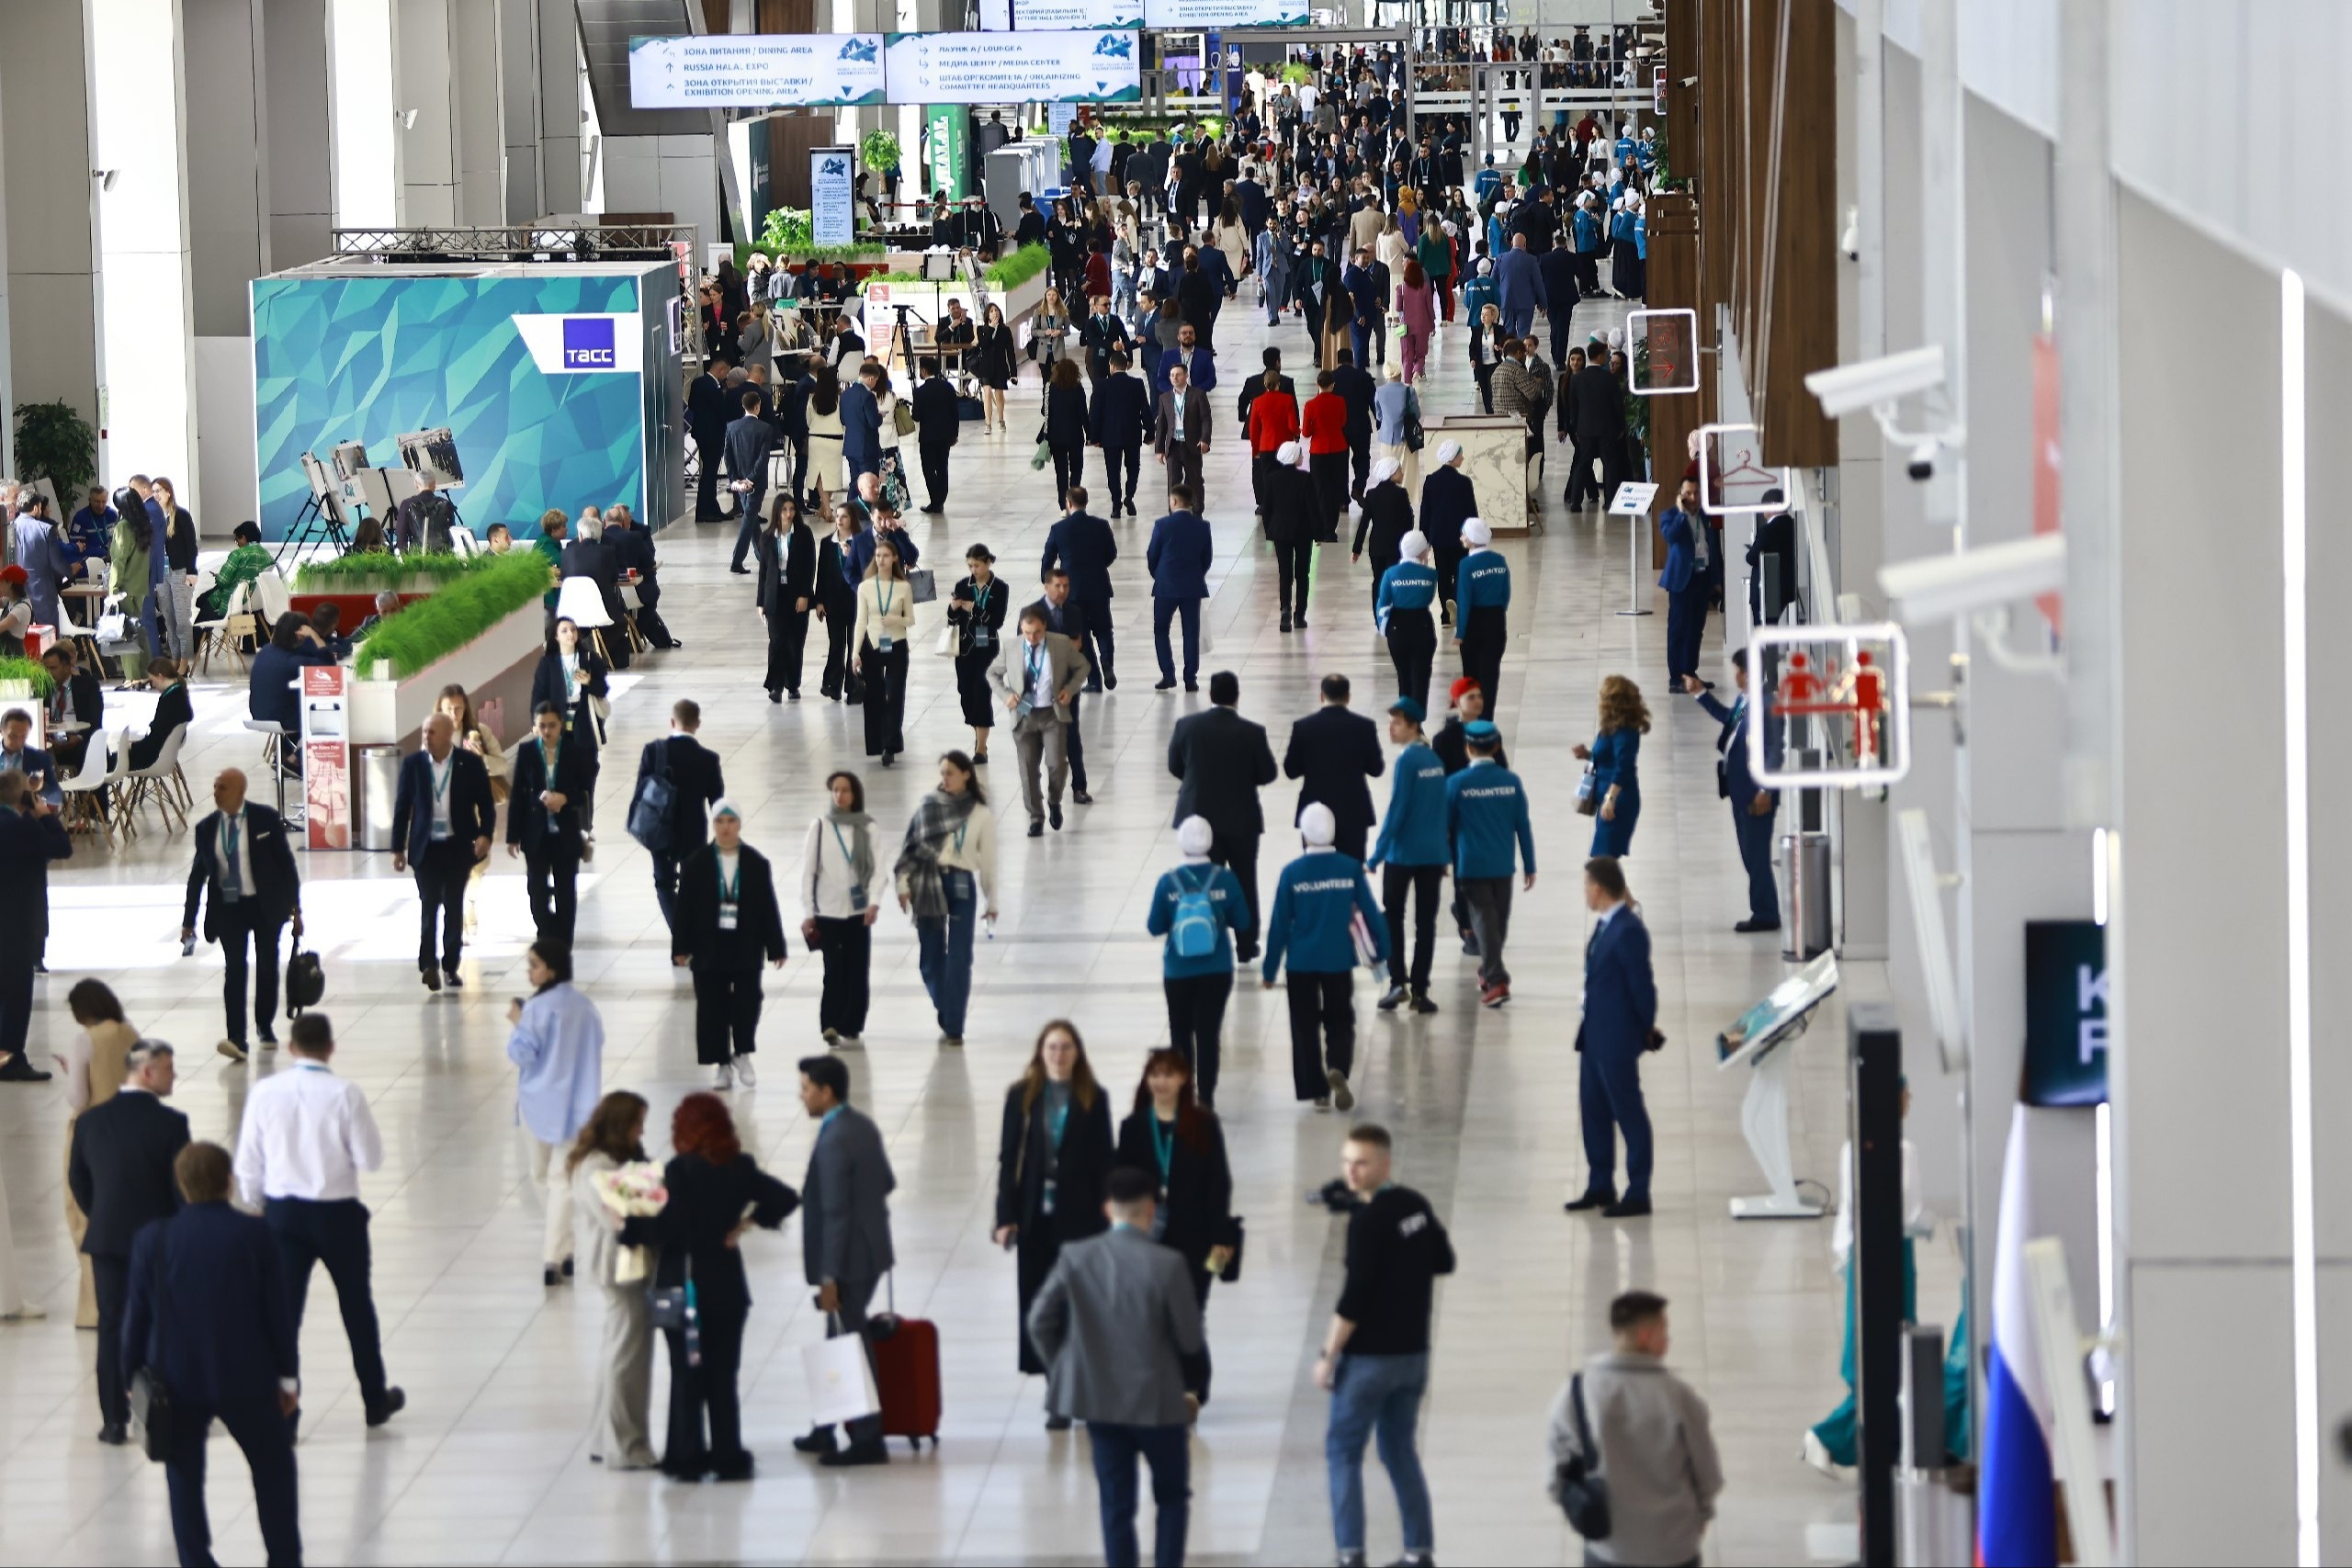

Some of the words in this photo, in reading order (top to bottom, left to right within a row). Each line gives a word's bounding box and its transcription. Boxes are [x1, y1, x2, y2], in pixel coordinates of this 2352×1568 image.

[709, 47, 751, 55] ПИТАНИЯ
[758, 46, 788, 54] DINING
[790, 46, 813, 54] AREA
[684, 63, 714, 72] RUSSIA
[746, 62, 769, 71] EXPO
[939, 60, 968, 68] МЕДИА
[684, 79, 709, 87] ЗОНА
[710, 78, 758, 86] ОТКРЫТИЯ
[760, 77, 808, 86] ВЫСТАВКИ
[939, 73, 963, 82] ШТАБ
[988, 82, 1051, 91] HEADQUARTERS
[684, 87, 734, 96] EXHIBITION
[736, 87, 775, 96] OPENING
[776, 87, 799, 96] AREA
[1462, 786, 1516, 797] VOLUNTEER
[1293, 878, 1355, 893] VOLUNTEER
